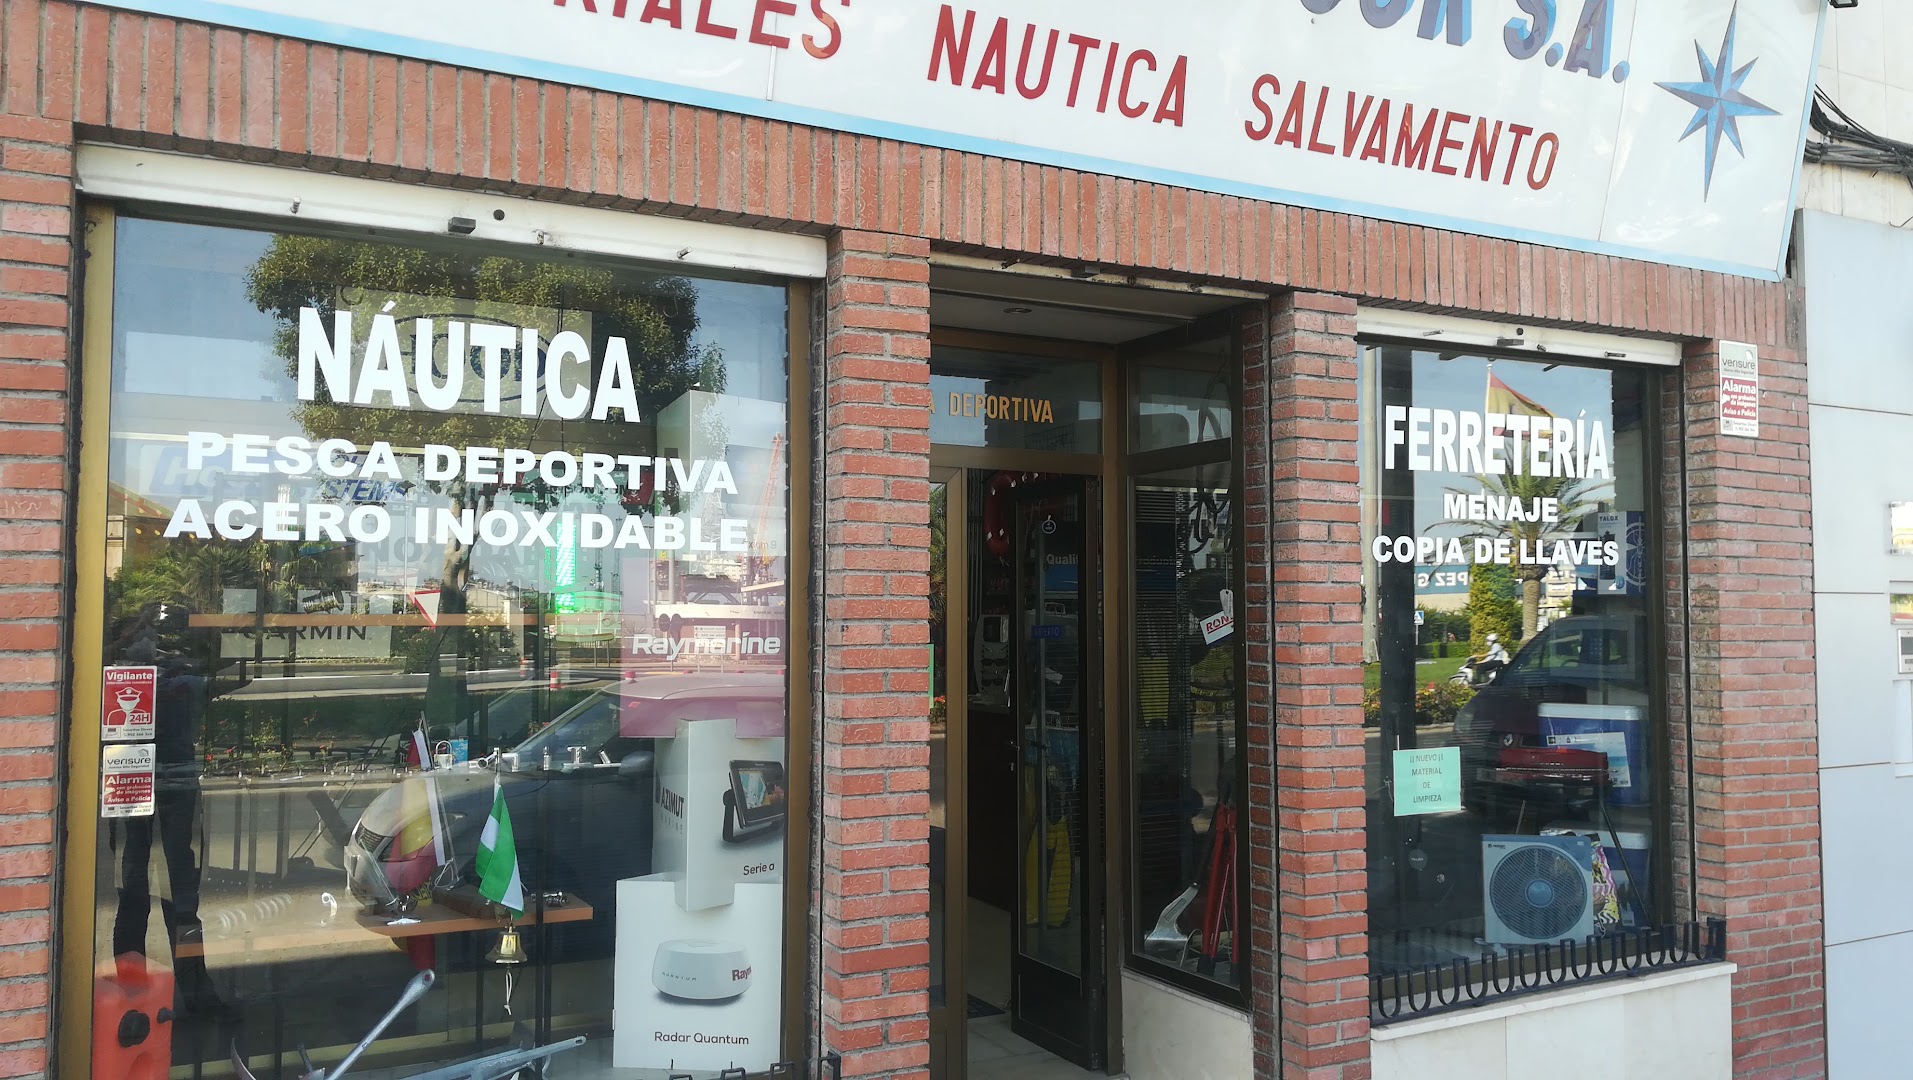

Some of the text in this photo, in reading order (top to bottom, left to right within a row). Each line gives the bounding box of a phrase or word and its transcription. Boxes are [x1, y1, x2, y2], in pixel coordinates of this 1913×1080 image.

[927, 4, 1187, 128] NAUTICA
[1245, 73, 1560, 191] SALVAMENTO
[298, 300, 642, 423] NÁUTICA
[1722, 358, 1756, 370] verisure
[1723, 380, 1756, 394] Alarma
[949, 391, 1054, 424] DEPORTIVA
[1723, 407, 1736, 415] Aviso
[1385, 405, 1610, 480] FERRETERÍA
[187, 431, 402, 480] PESCA
[424, 444, 739, 495] DEPORTIVA
[1443, 493, 1558, 523] MENAJE
[164, 499, 391, 543] ACERO
[417, 504, 749, 552] INOXIDABLE
[1372, 535, 1620, 566] COPIA DE LLAVES
[632, 632, 781, 661] Raymarine
[106, 671, 153, 682] Vigilante
[129, 714, 150, 722] 24H
[107, 757, 152, 765] verisure
[1416, 754, 1437, 762] NUEVO
[1411, 767, 1442, 776] MATERIAL
[106, 775, 152, 785] Alarma
[1423, 781, 1431, 789] DE
[661, 787, 684, 819] AZIMUT
[1413, 794, 1442, 803] LIMPIEZA
[743, 862, 775, 876] Serie a
[654, 1031, 749, 1045] Radar Quantum
